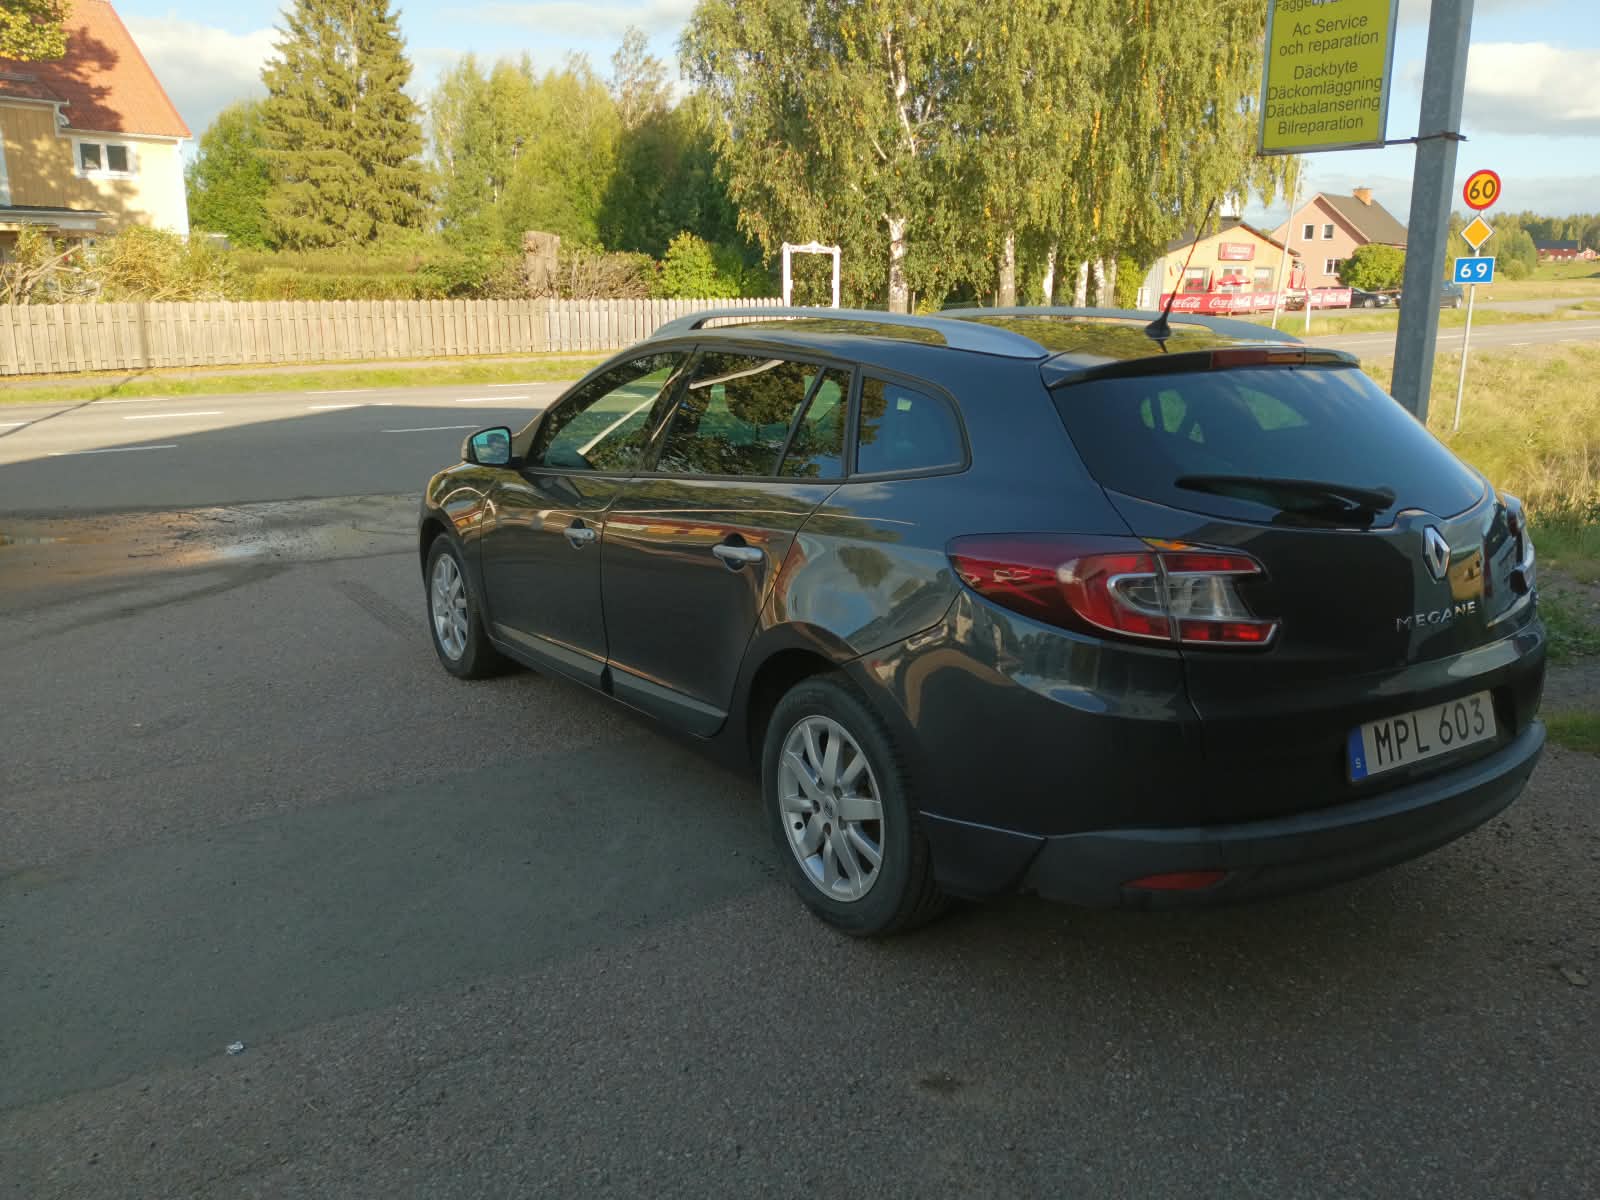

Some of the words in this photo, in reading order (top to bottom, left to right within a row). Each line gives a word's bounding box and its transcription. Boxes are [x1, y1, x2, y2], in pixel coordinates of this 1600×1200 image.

[1292, 23, 1312, 37] Ac
[1315, 15, 1369, 34] Service
[1279, 43, 1304, 57] och
[1309, 31, 1379, 54] reparation
[1293, 60, 1359, 80] Däckbyte
[1267, 76, 1383, 101] Däckomläggning
[1265, 95, 1382, 119] Däckbalansering
[1278, 115, 1364, 136] Bilreparation
[1469, 179, 1496, 200] 60
[1460, 262, 1488, 279] 69
[1396, 600, 1477, 632] MEGANE
[1373, 712, 1431, 767] MPL
[1439, 696, 1485, 746] 603
[1354, 757, 1362, 769] S
